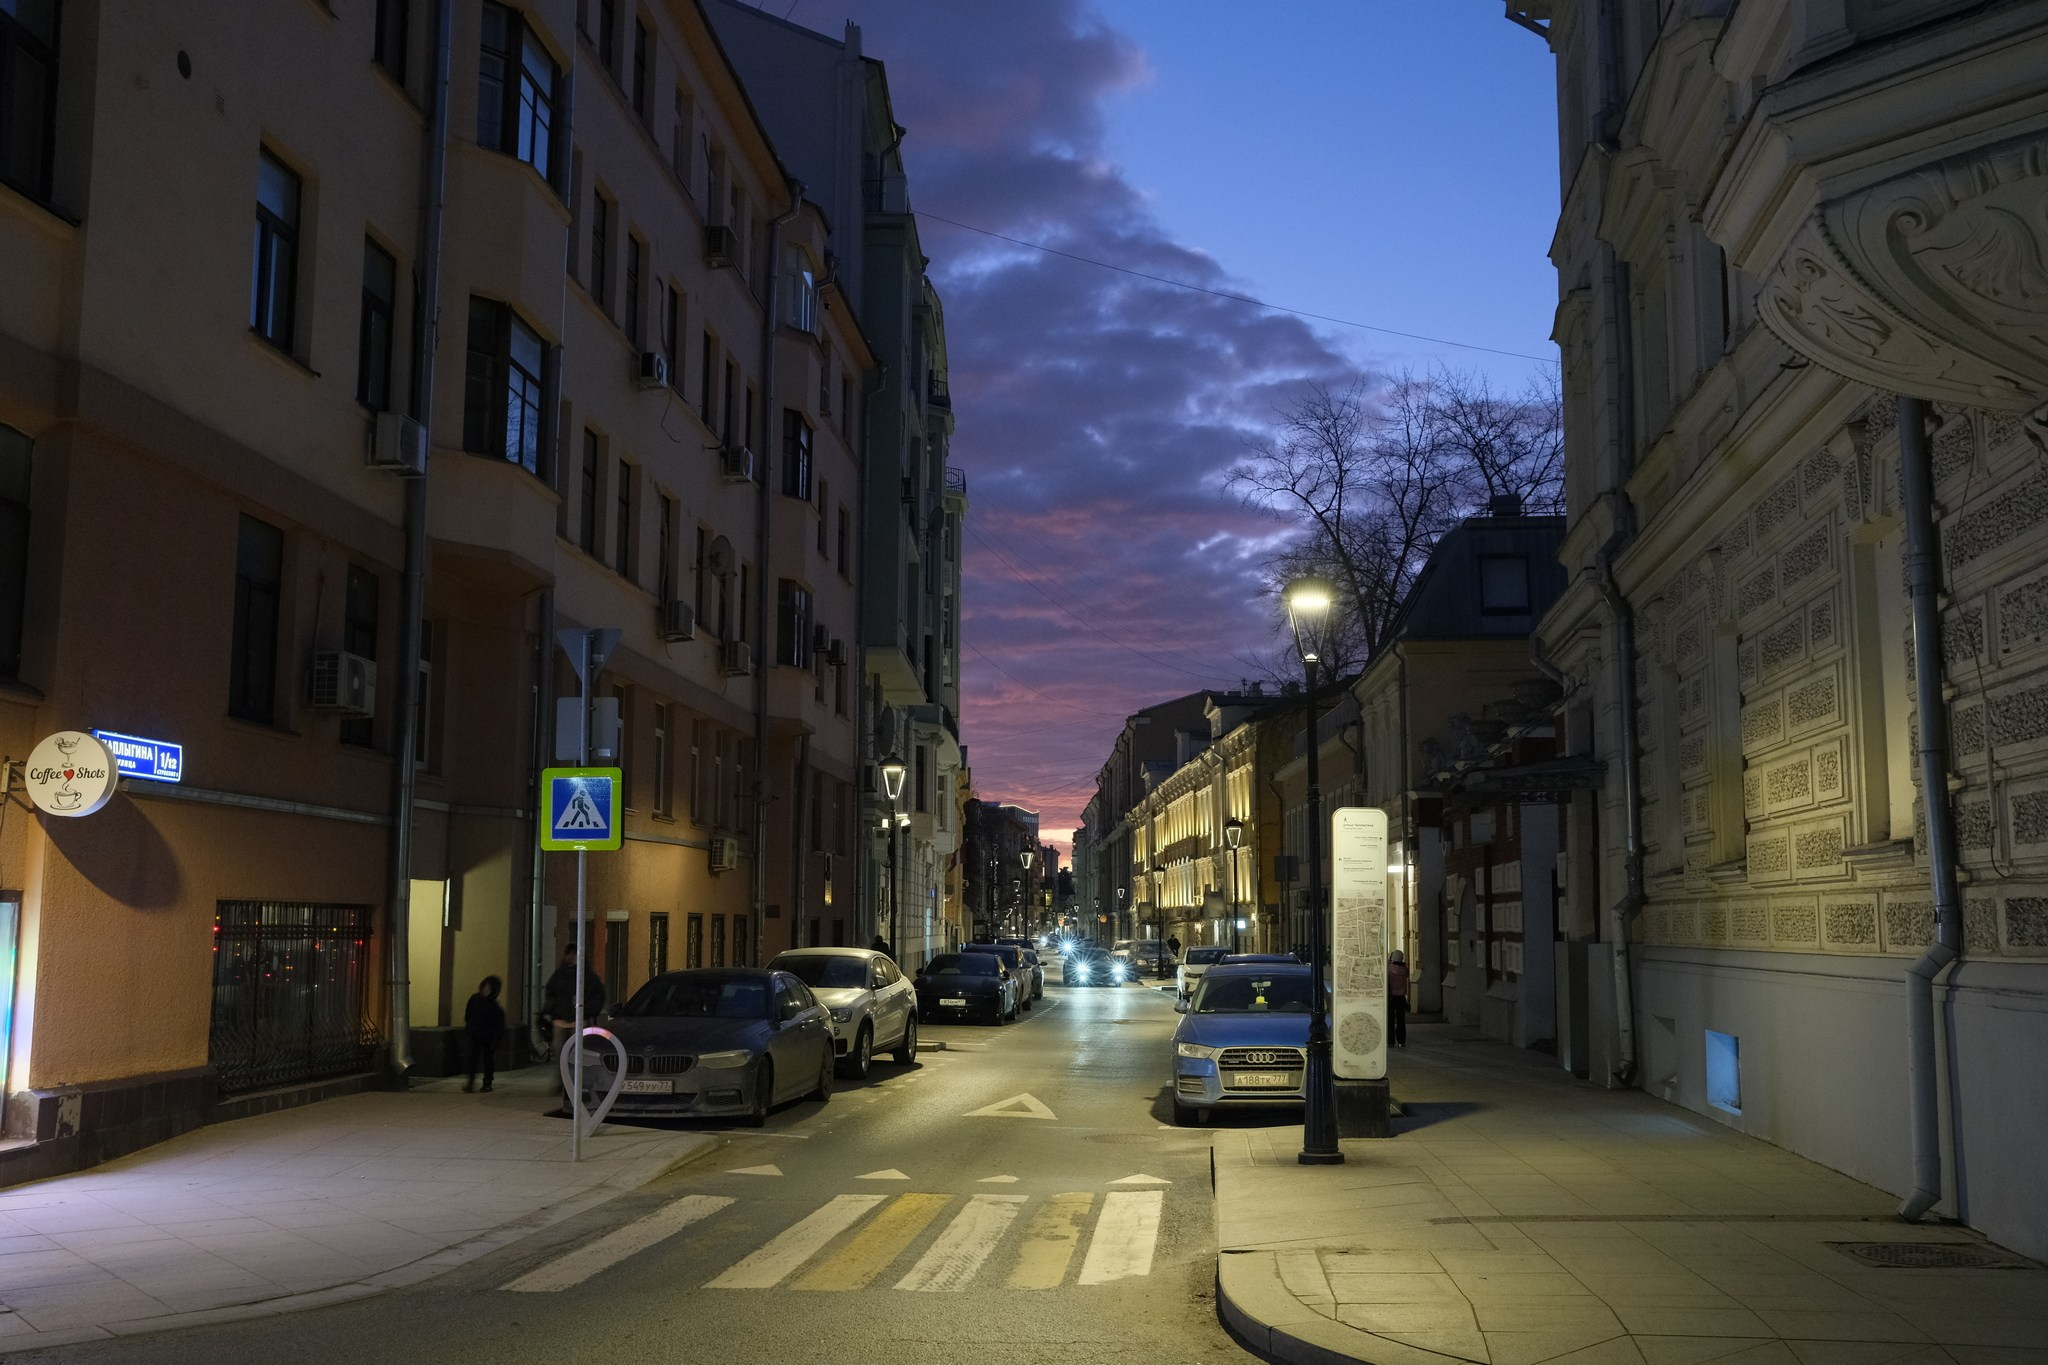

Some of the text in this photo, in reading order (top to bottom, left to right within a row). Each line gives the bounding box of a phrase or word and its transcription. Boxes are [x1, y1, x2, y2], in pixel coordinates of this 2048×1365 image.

[160, 752, 177, 769] 1/12
[30, 767, 105, 785] Coffee Shots
